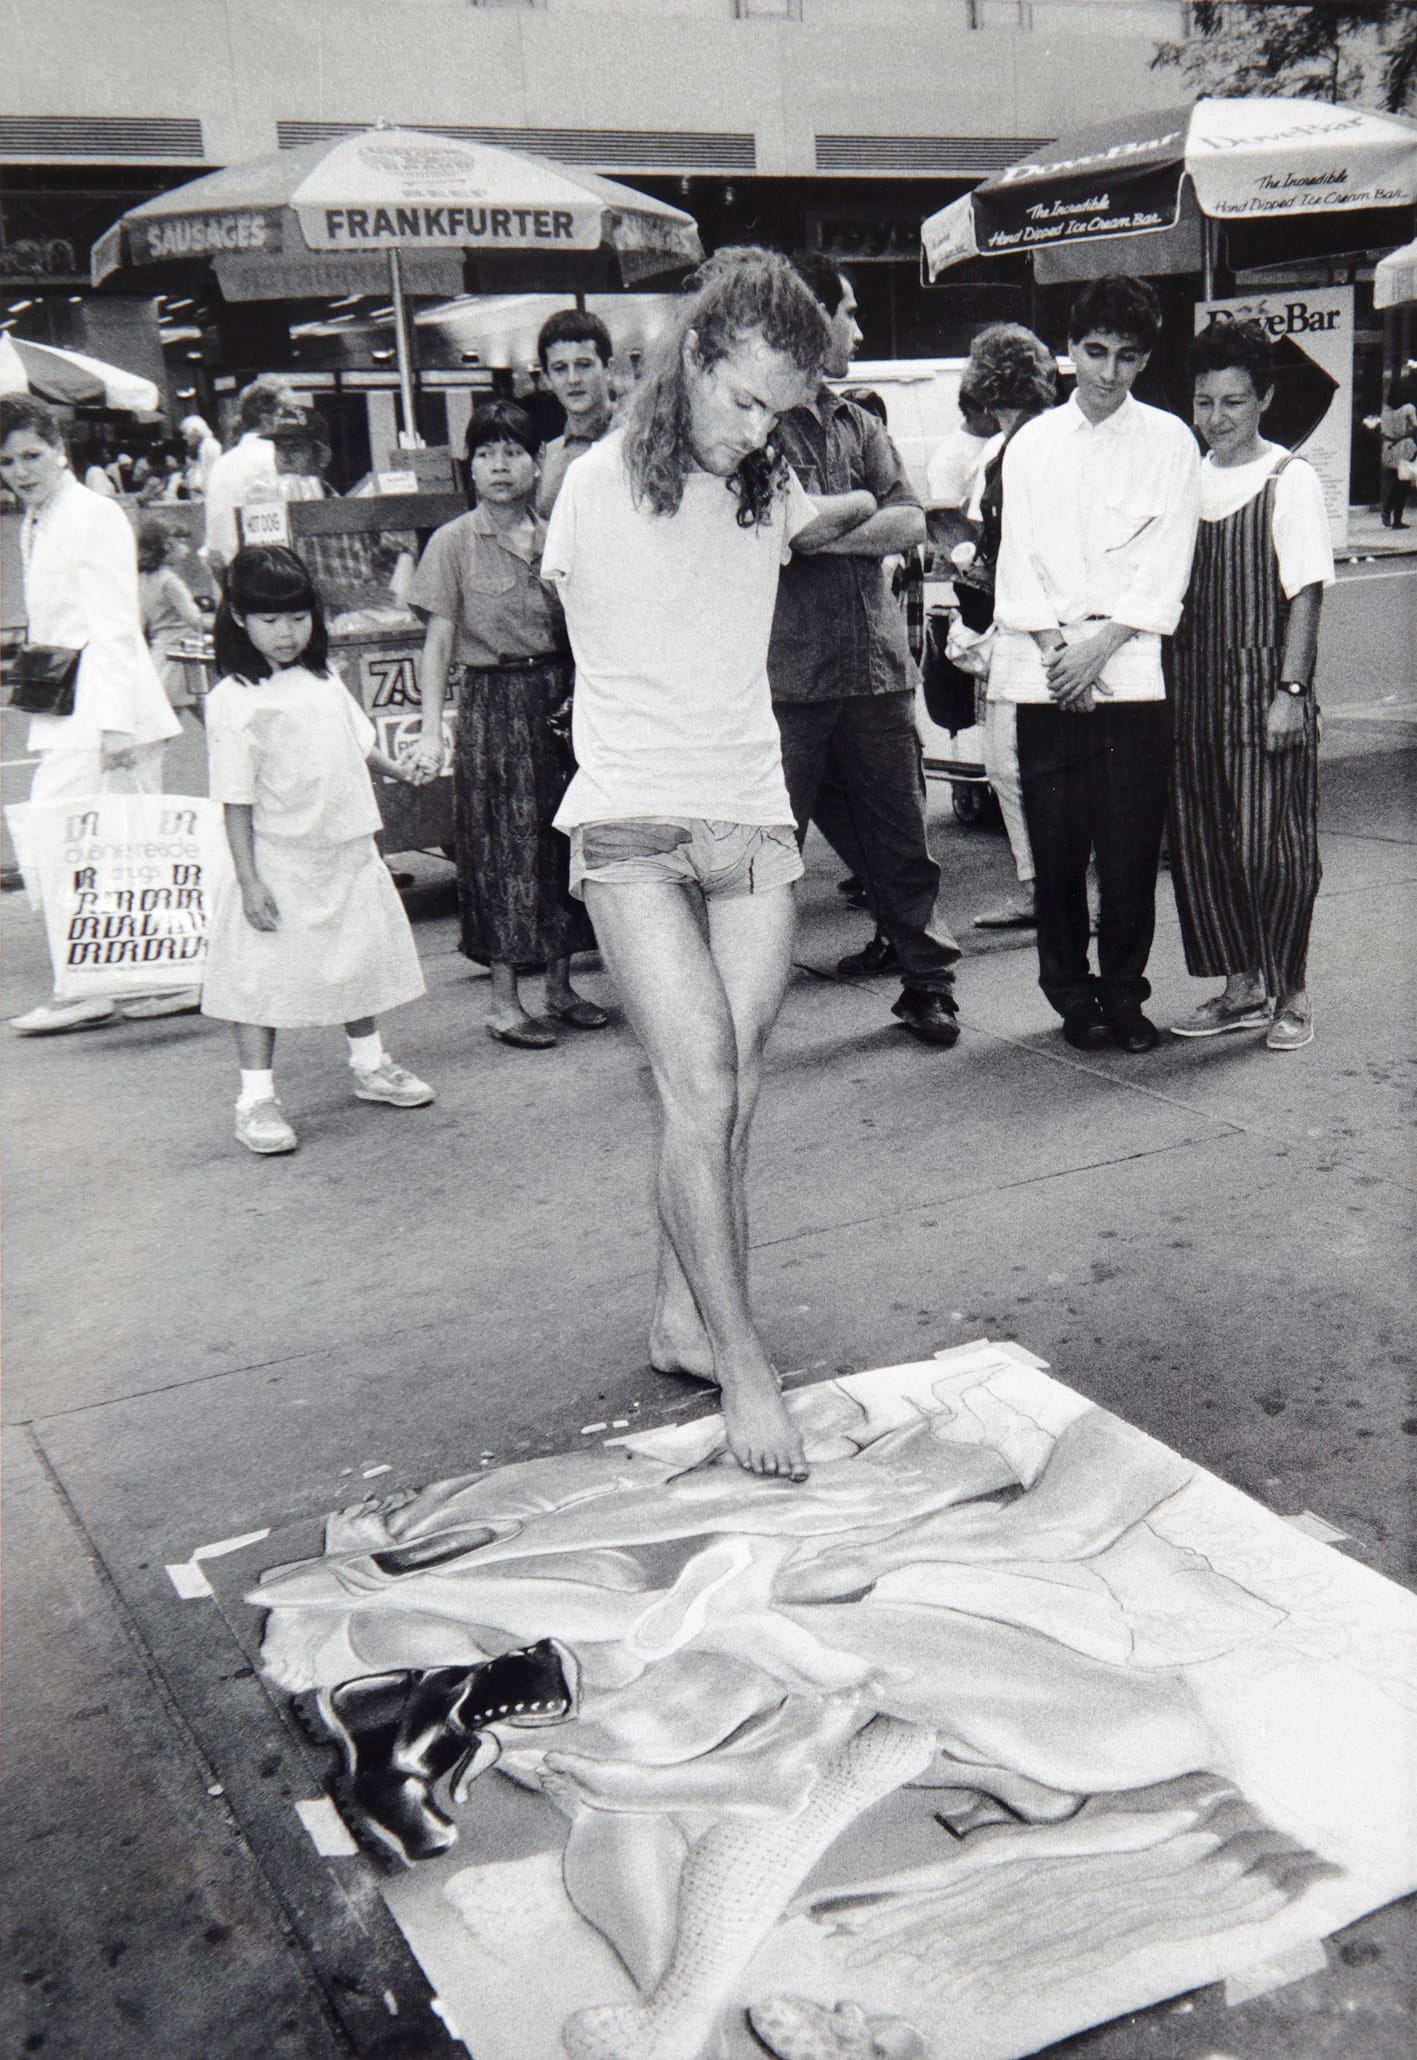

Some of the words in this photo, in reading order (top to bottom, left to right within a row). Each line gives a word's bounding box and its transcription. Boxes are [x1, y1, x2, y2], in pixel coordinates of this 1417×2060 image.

[1256, 174, 1278, 189] The
[1279, 168, 1349, 188] Incredible
[1026, 203, 1050, 220] The
[1049, 193, 1111, 217] Incredible
[1214, 201, 1247, 213] Hand
[1249, 195, 1297, 212] Dipped
[1301, 193, 1322, 206] Ice
[1323, 191, 1370, 205] Cream
[1374, 187, 1409, 200] Bar
[147, 214, 267, 257] SAUSAGES
[325, 207, 574, 239] FRANKFURTER
[988, 228, 1023, 247] Hand
[1023, 221, 1064, 242] Dipped
[1065, 219, 1088, 235] Ice
[1087, 216, 1131, 232] Cream
[1132, 211, 1163, 226] Bar
